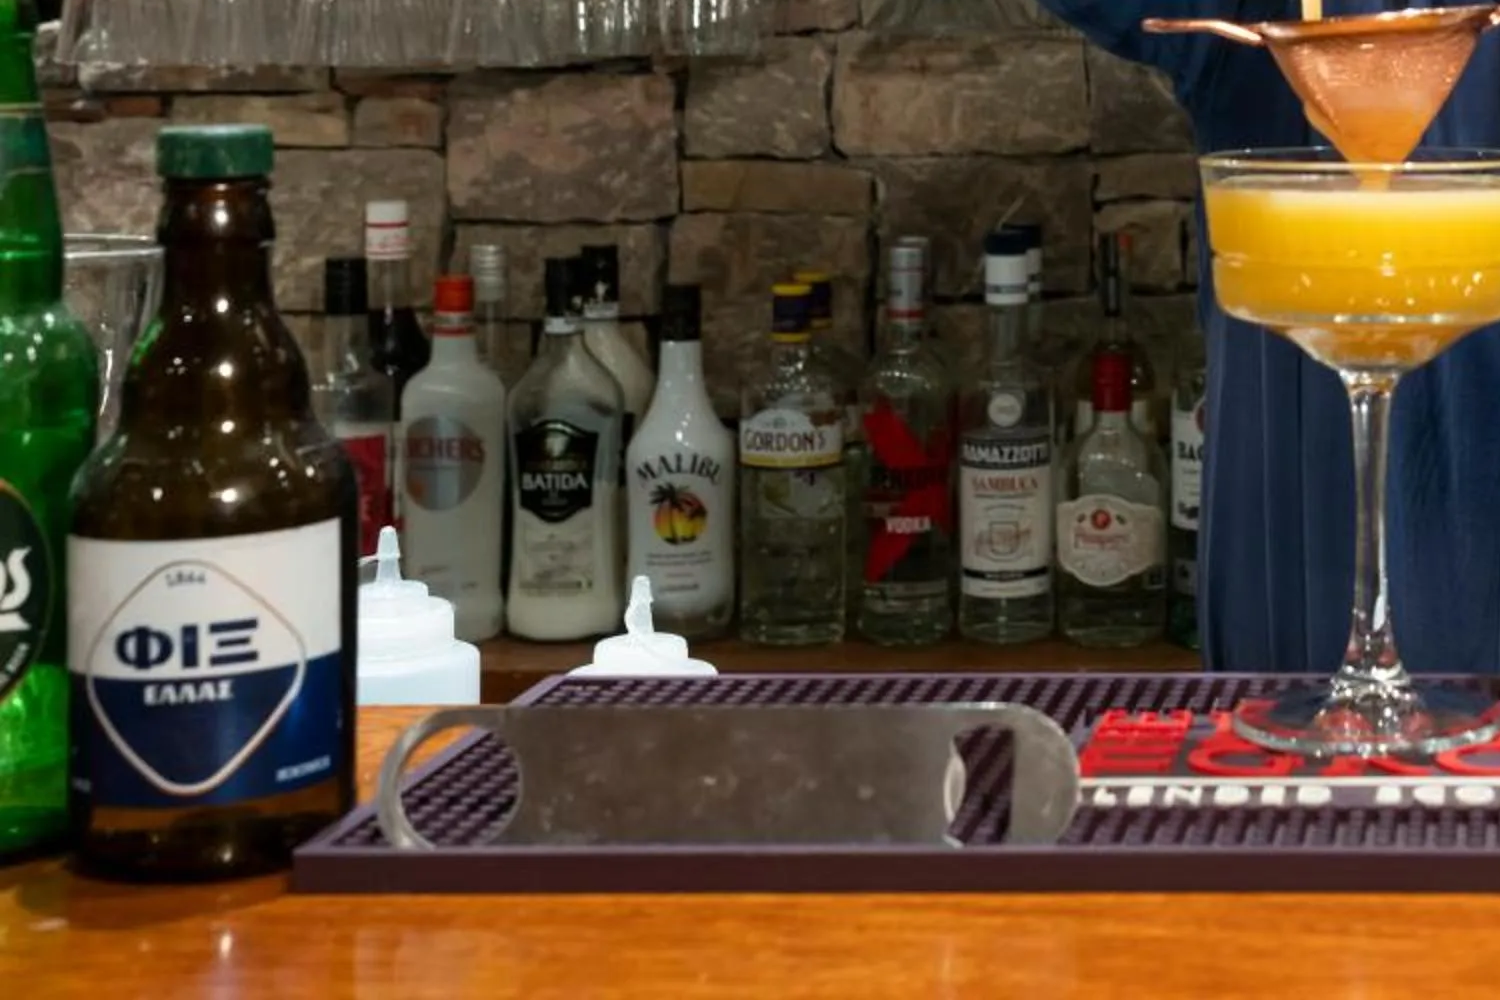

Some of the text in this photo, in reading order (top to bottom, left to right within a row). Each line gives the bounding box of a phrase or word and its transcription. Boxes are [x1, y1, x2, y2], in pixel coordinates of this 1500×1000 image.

[522, 472, 589, 491] BATIDA
[885, 515, 932, 534] VODKA
[115, 617, 259, 670] ΦΙΞ
[143, 679, 235, 707] ΕΛΛΑΣ
[1078, 784, 1331, 806] LENDED
